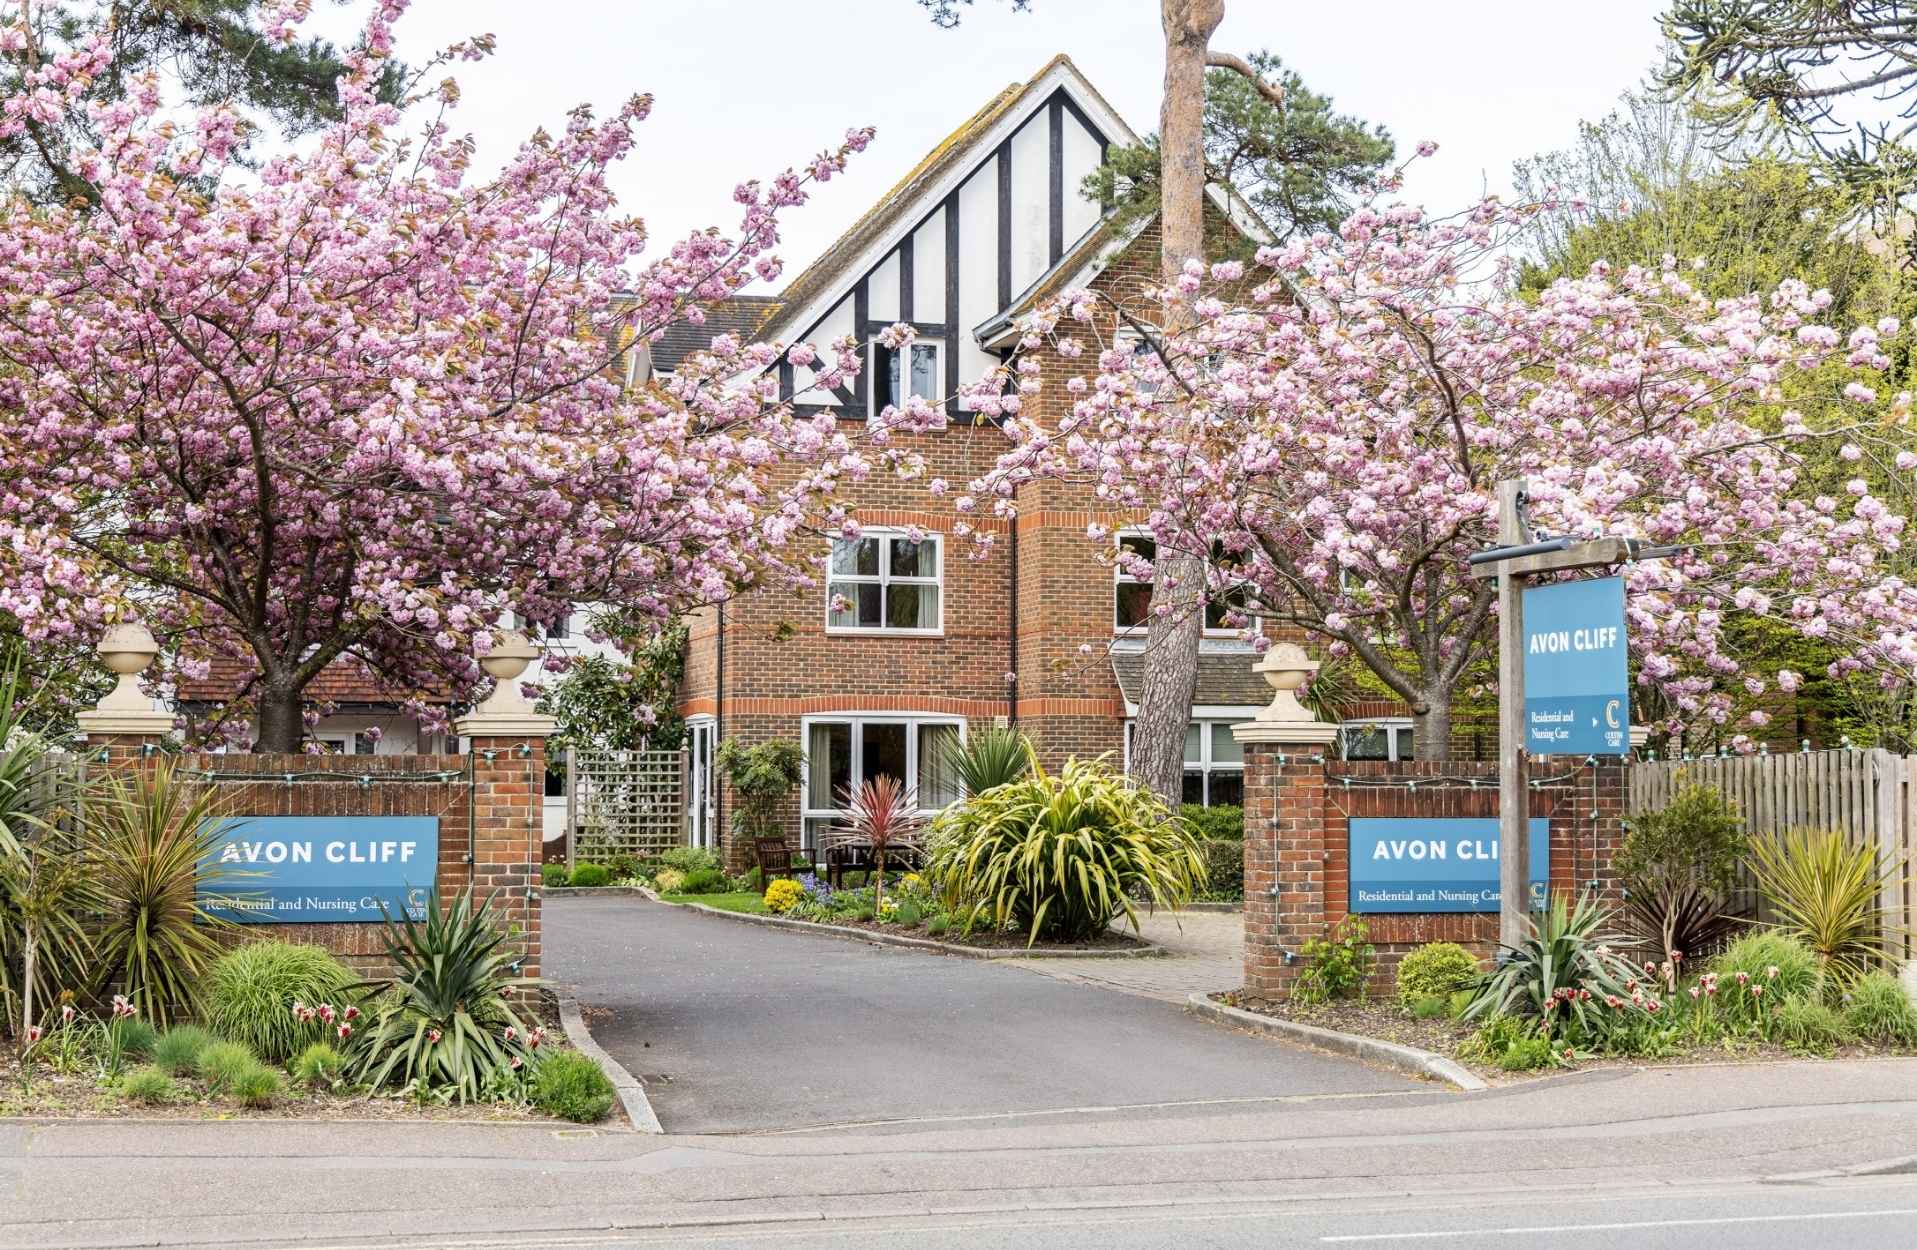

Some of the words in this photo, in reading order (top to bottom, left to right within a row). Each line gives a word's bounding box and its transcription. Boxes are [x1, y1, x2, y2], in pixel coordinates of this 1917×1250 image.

[1530, 632, 1569, 654] AVON
[1574, 627, 1617, 650] CLIFF
[1531, 710, 1561, 723] Residential
[1562, 710, 1574, 722] and
[1531, 728, 1554, 742] Nursing
[1555, 727, 1568, 739] Care
[221, 841, 312, 863] AVON
[326, 841, 417, 863] CLIFF
[1373, 840, 1446, 859] AVON
[1456, 840, 1498, 859] CLI
[279, 897, 301, 910] and
[307, 897, 357, 912] Nursing
[1359, 890, 1413, 901] Residential
[1416, 890, 1434, 901] and
[1439, 890, 1479, 904] Nursing
